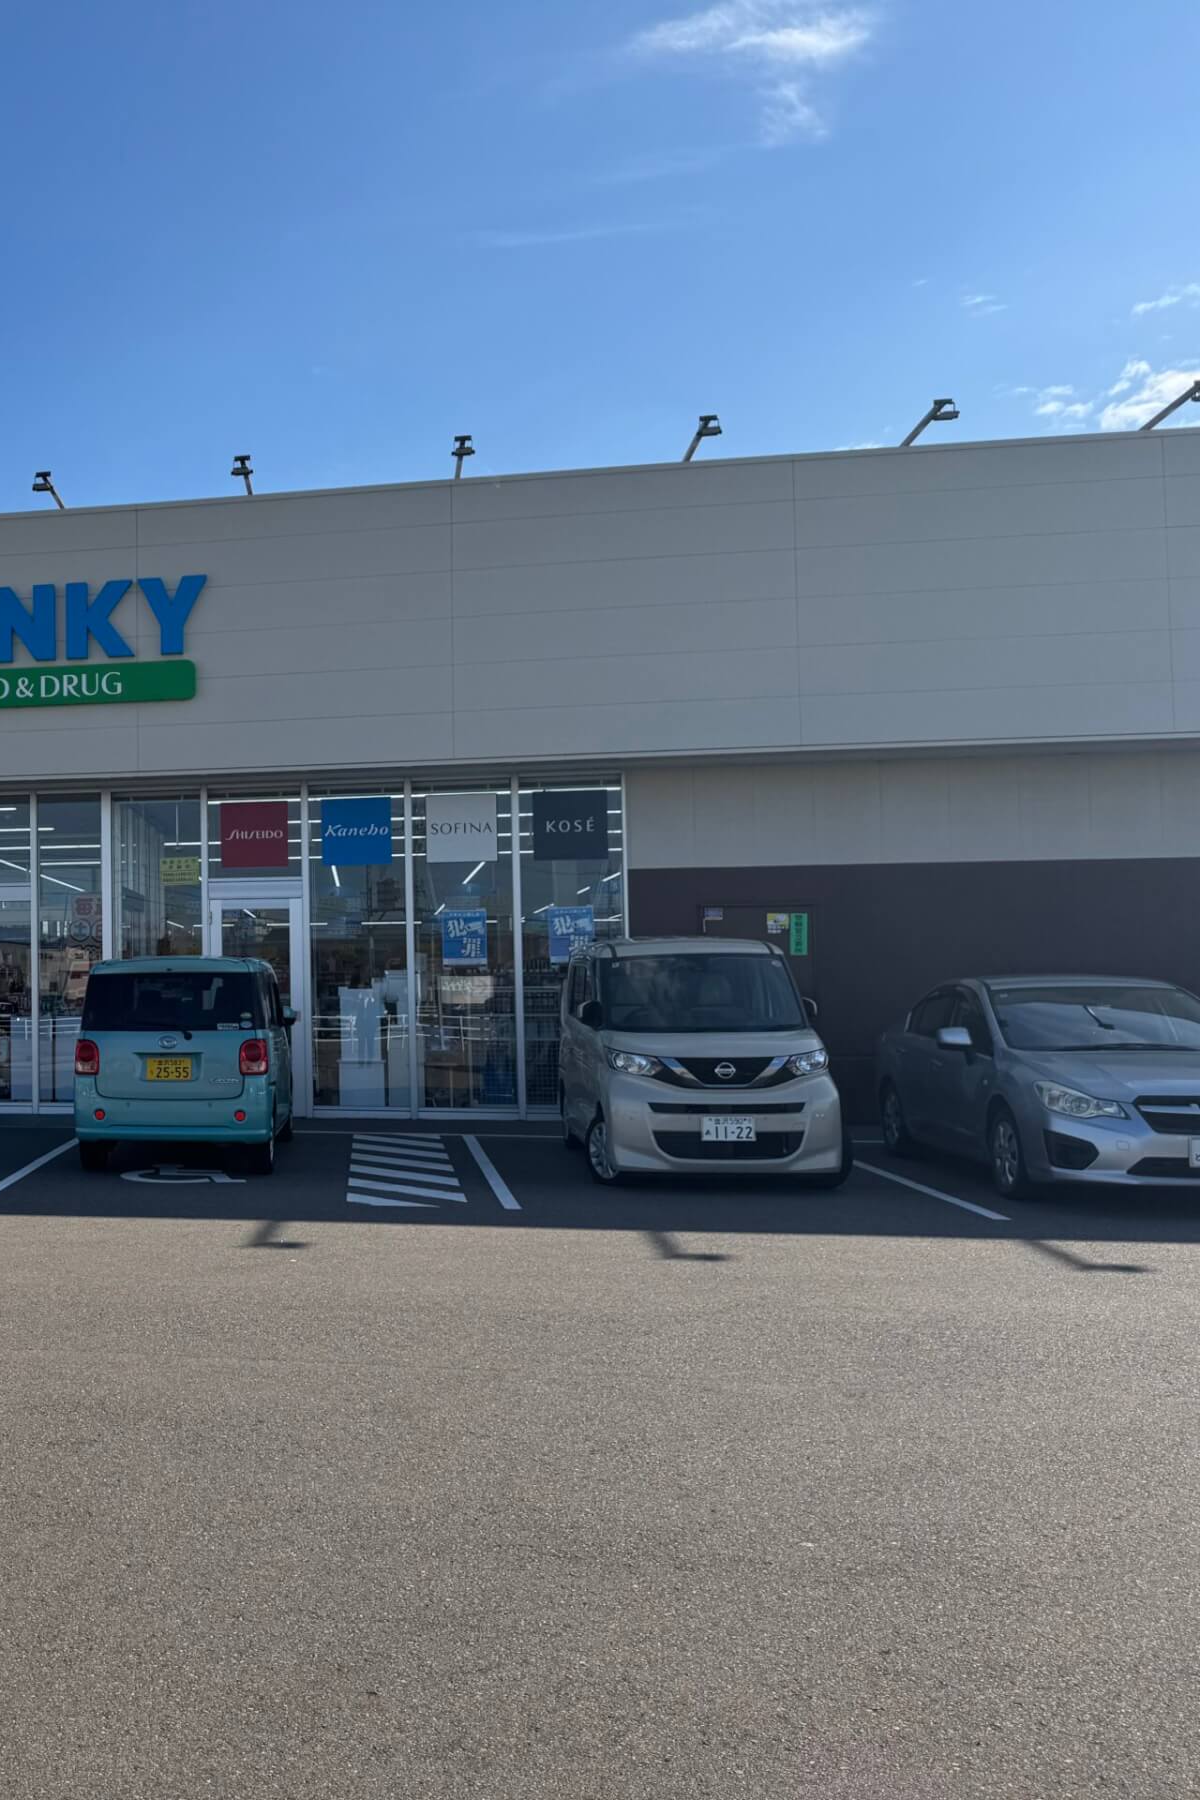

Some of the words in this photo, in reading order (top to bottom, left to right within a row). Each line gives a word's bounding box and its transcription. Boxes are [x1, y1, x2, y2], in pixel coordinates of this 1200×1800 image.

[324, 822, 389, 838] Kanebo
[430, 820, 494, 836] SOFINA
[545, 816, 596, 834] KOSÉ
[225, 828, 284, 841] SHISEIDO
[156, 1067, 189, 1079] 25-55
[715, 1126, 753, 1140] 11-22
